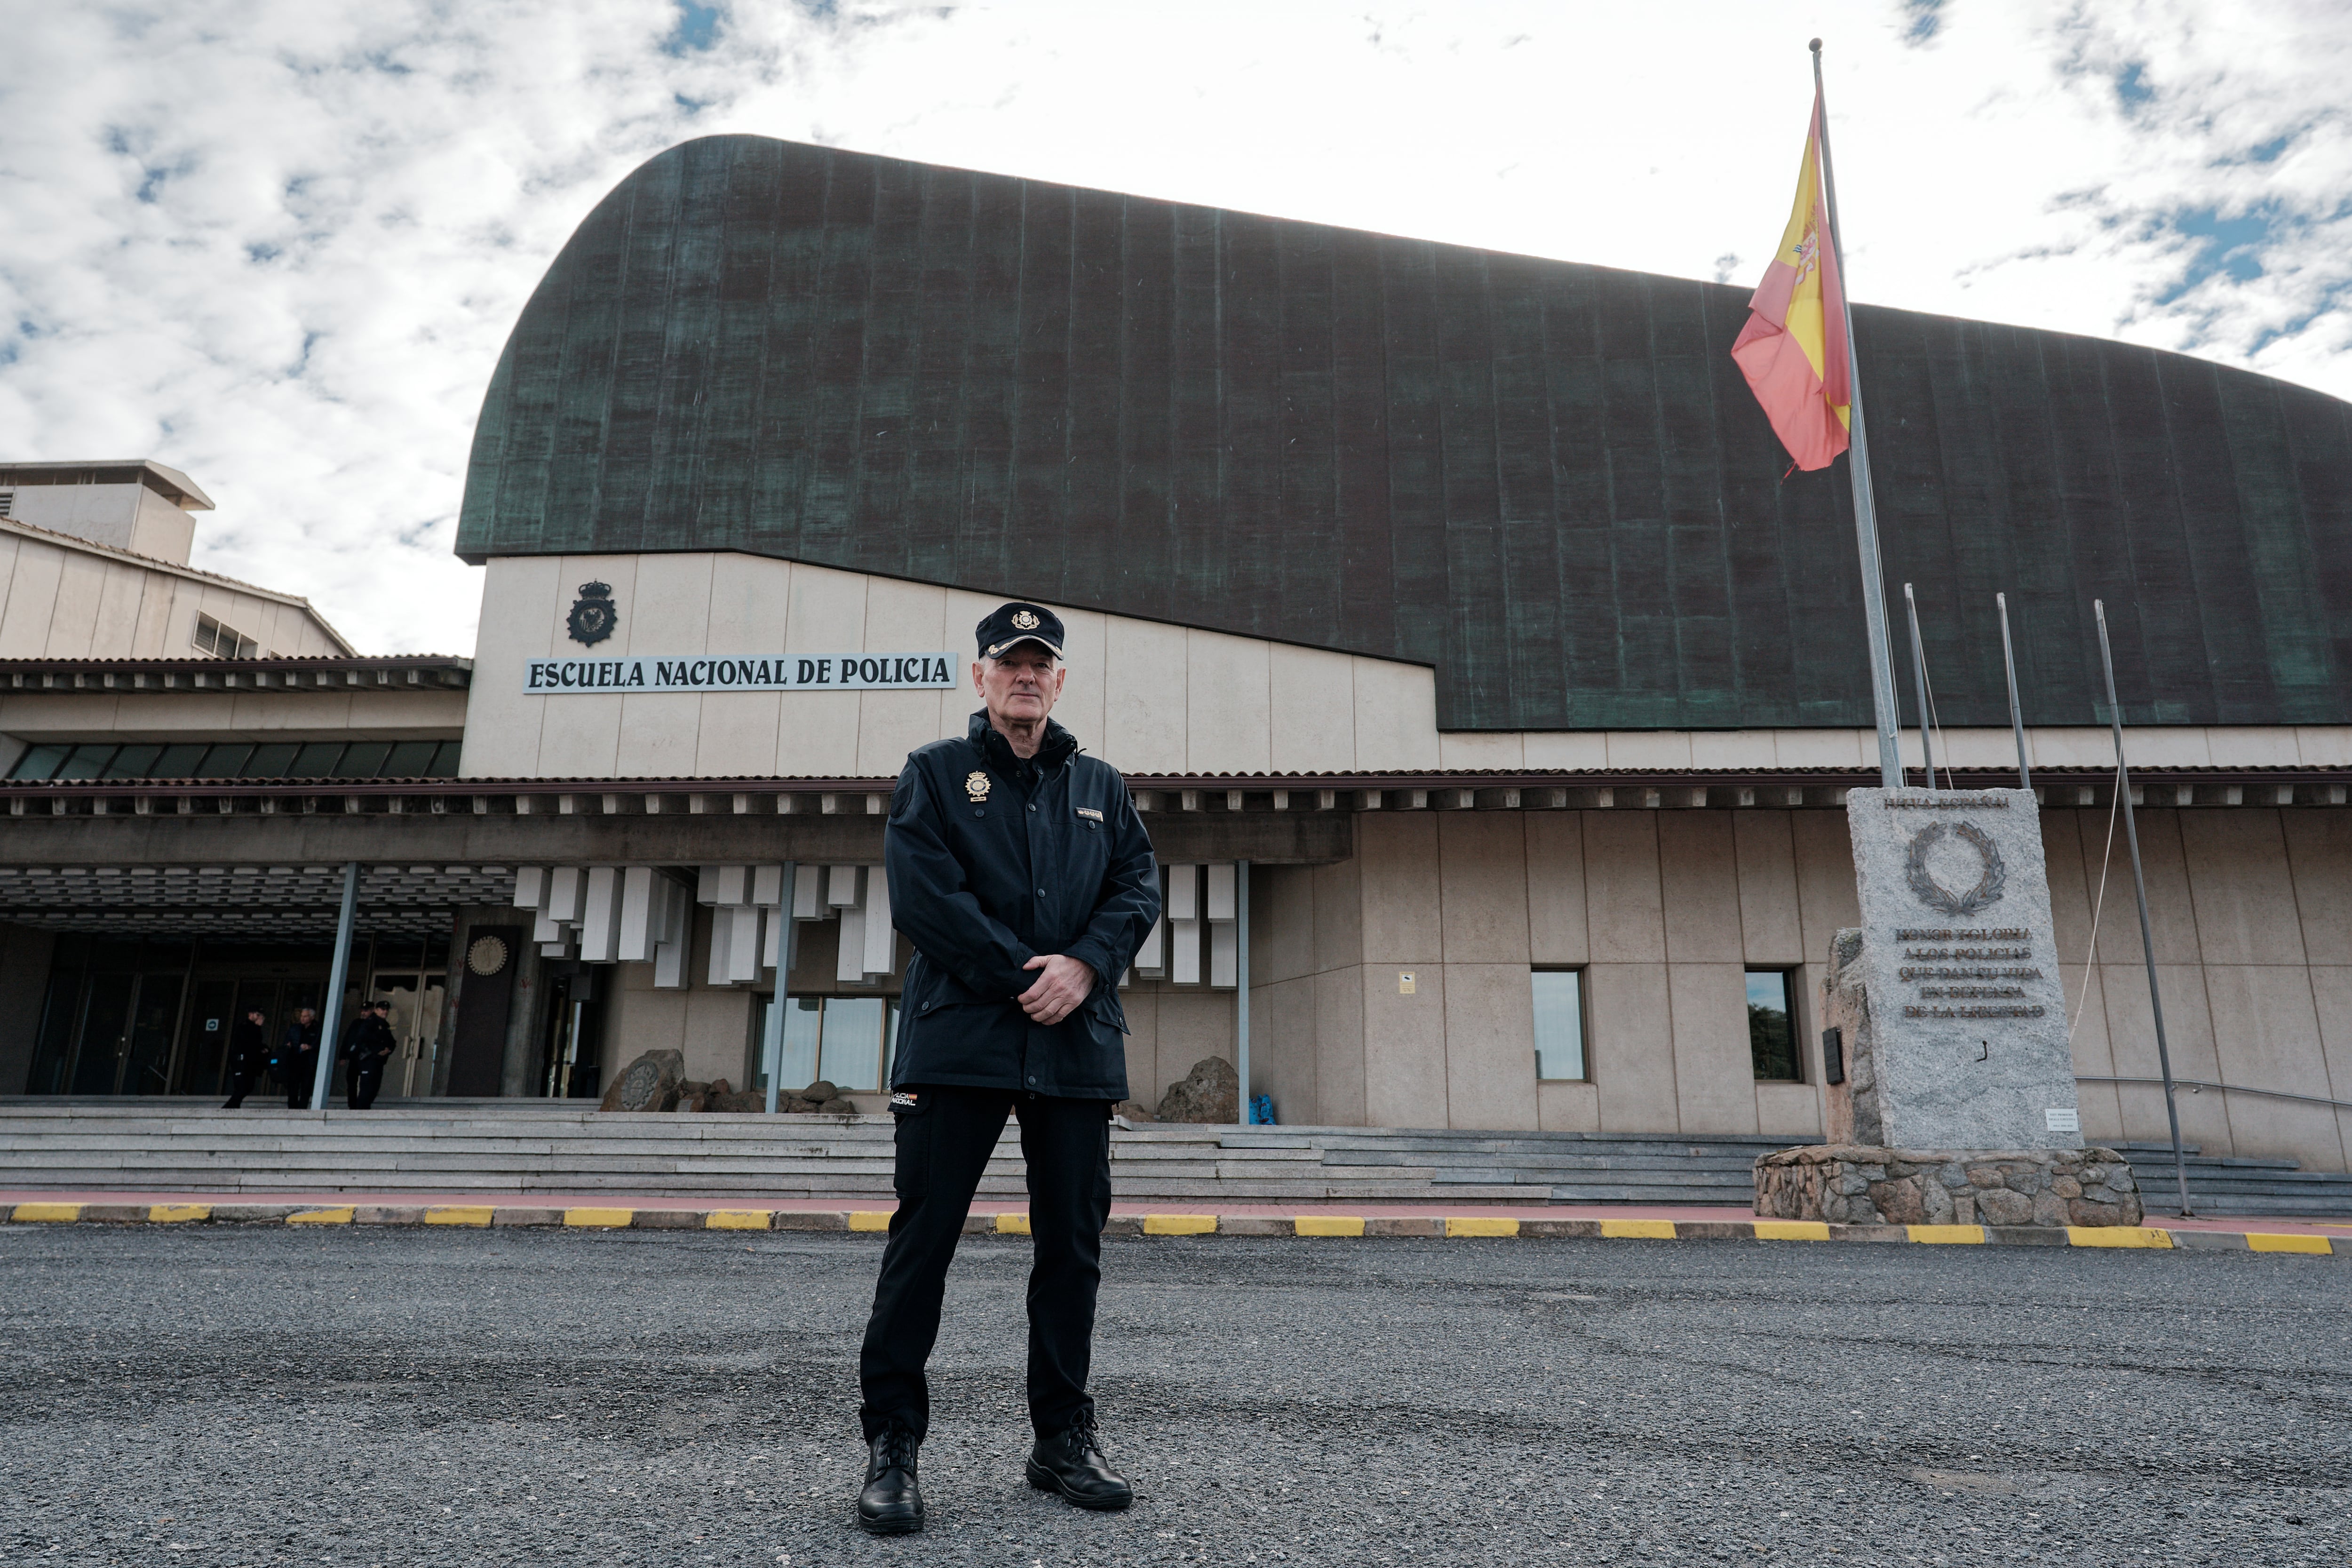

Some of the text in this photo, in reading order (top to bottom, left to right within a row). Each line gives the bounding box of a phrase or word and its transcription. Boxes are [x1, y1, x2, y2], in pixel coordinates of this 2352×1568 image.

[529, 658, 950, 688] ESCUELA NACIONAL DE POLICIA
[1896, 927, 2033, 940] HONOR Y GLORIA
[1903, 947, 2033, 960] A LOS POLICIAS
[1899, 966, 2044, 982] QUE DAN SU VIDA
[1920, 986, 2027, 999] EN DEFENSA
[1905, 1005, 2046, 1018] DE LA LIBERTAD
